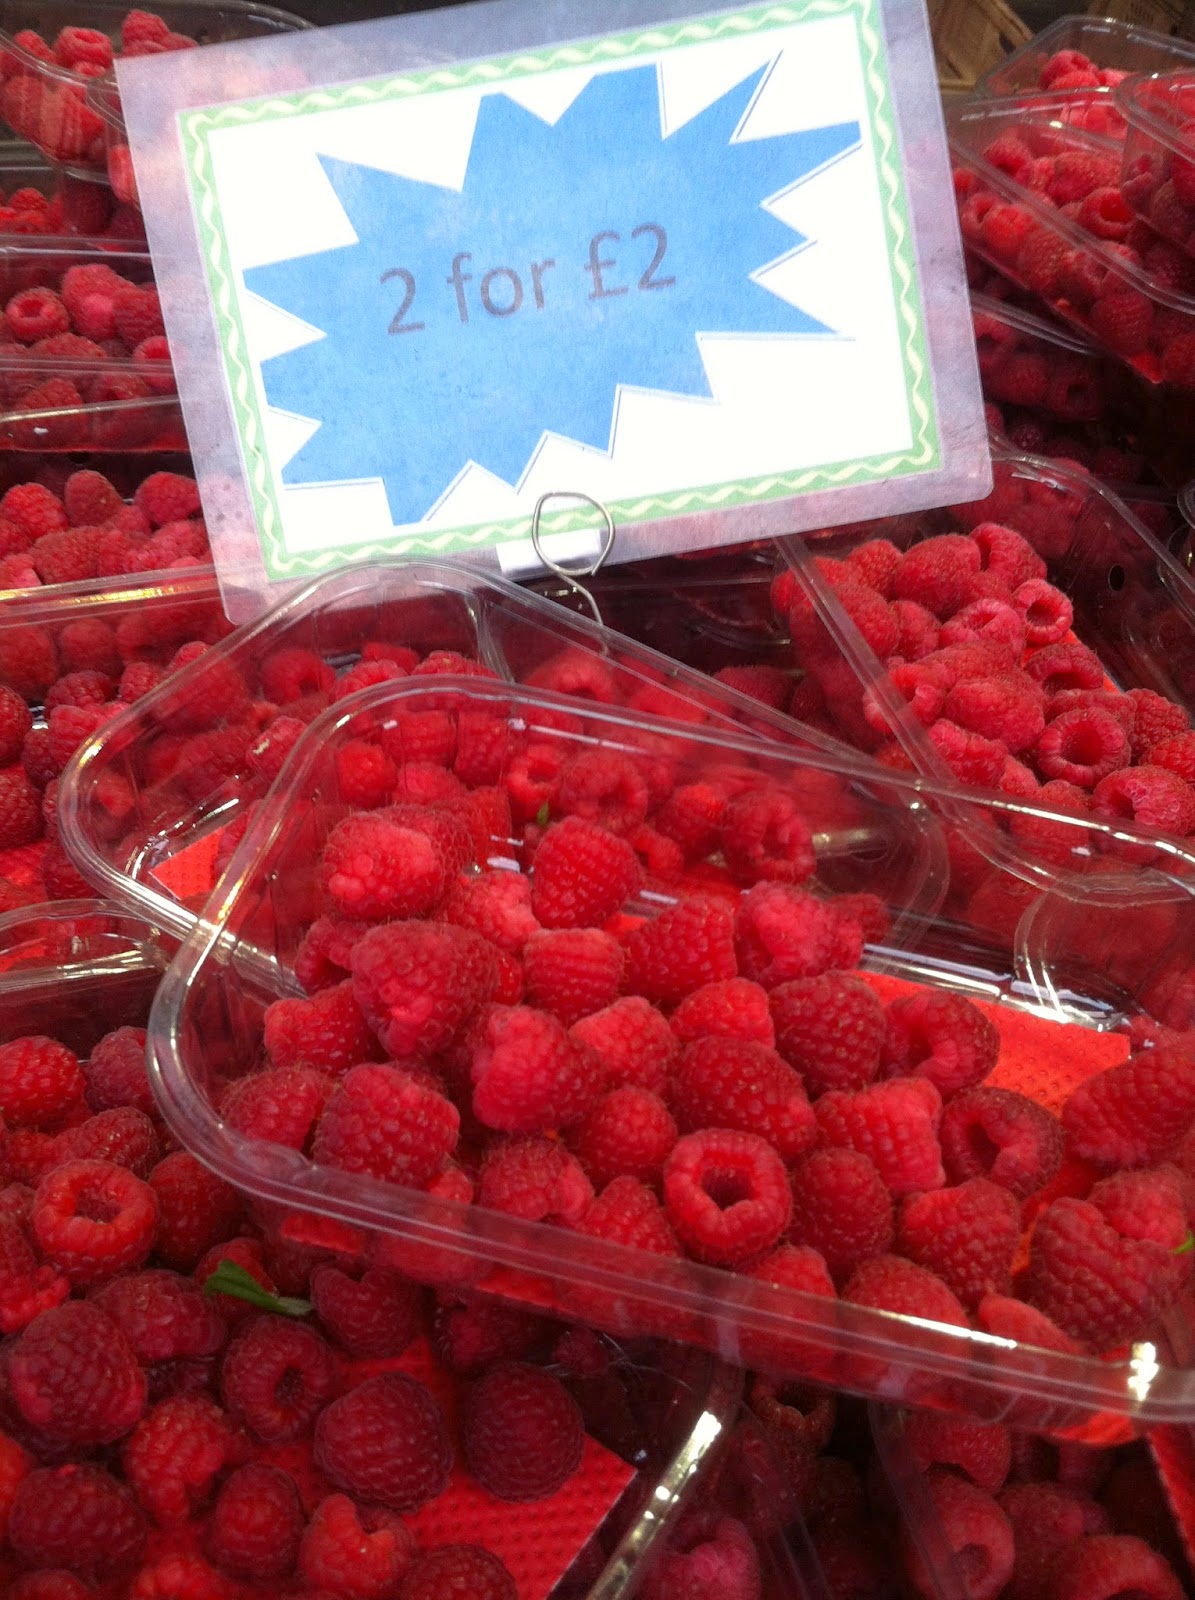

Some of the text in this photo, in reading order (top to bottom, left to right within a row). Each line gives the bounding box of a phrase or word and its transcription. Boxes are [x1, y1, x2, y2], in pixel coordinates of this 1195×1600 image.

[380, 222, 677, 335] 2 for £2
